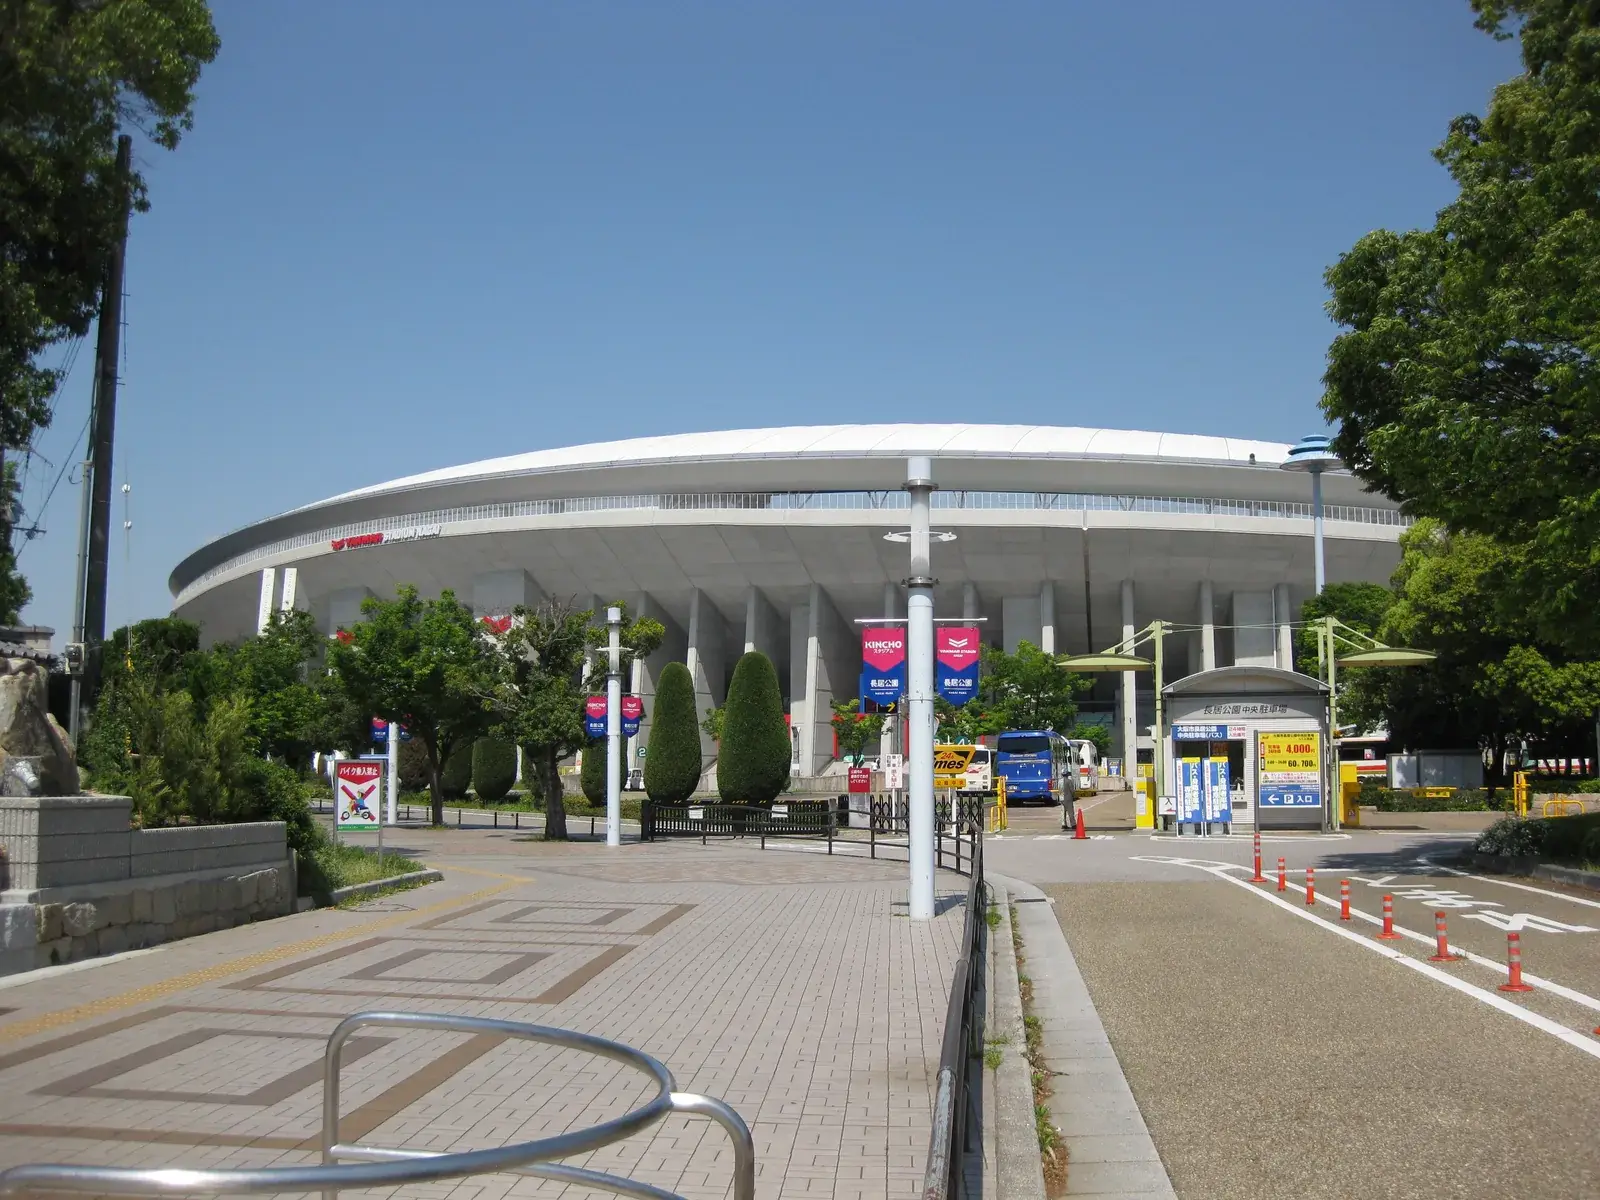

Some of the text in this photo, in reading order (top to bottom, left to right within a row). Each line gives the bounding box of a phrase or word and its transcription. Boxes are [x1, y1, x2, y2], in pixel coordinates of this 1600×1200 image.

[865, 640, 902, 649] KINCHO
[870, 679, 899, 688] 長居公園
[944, 678, 973, 687] 長居公園
[1203, 704, 1288, 715] 長居公園中央駐車場
[638, 747, 646, 757] 2
[1164, 797, 1173, 806] 入
[1297, 795, 1313, 803] 入口
